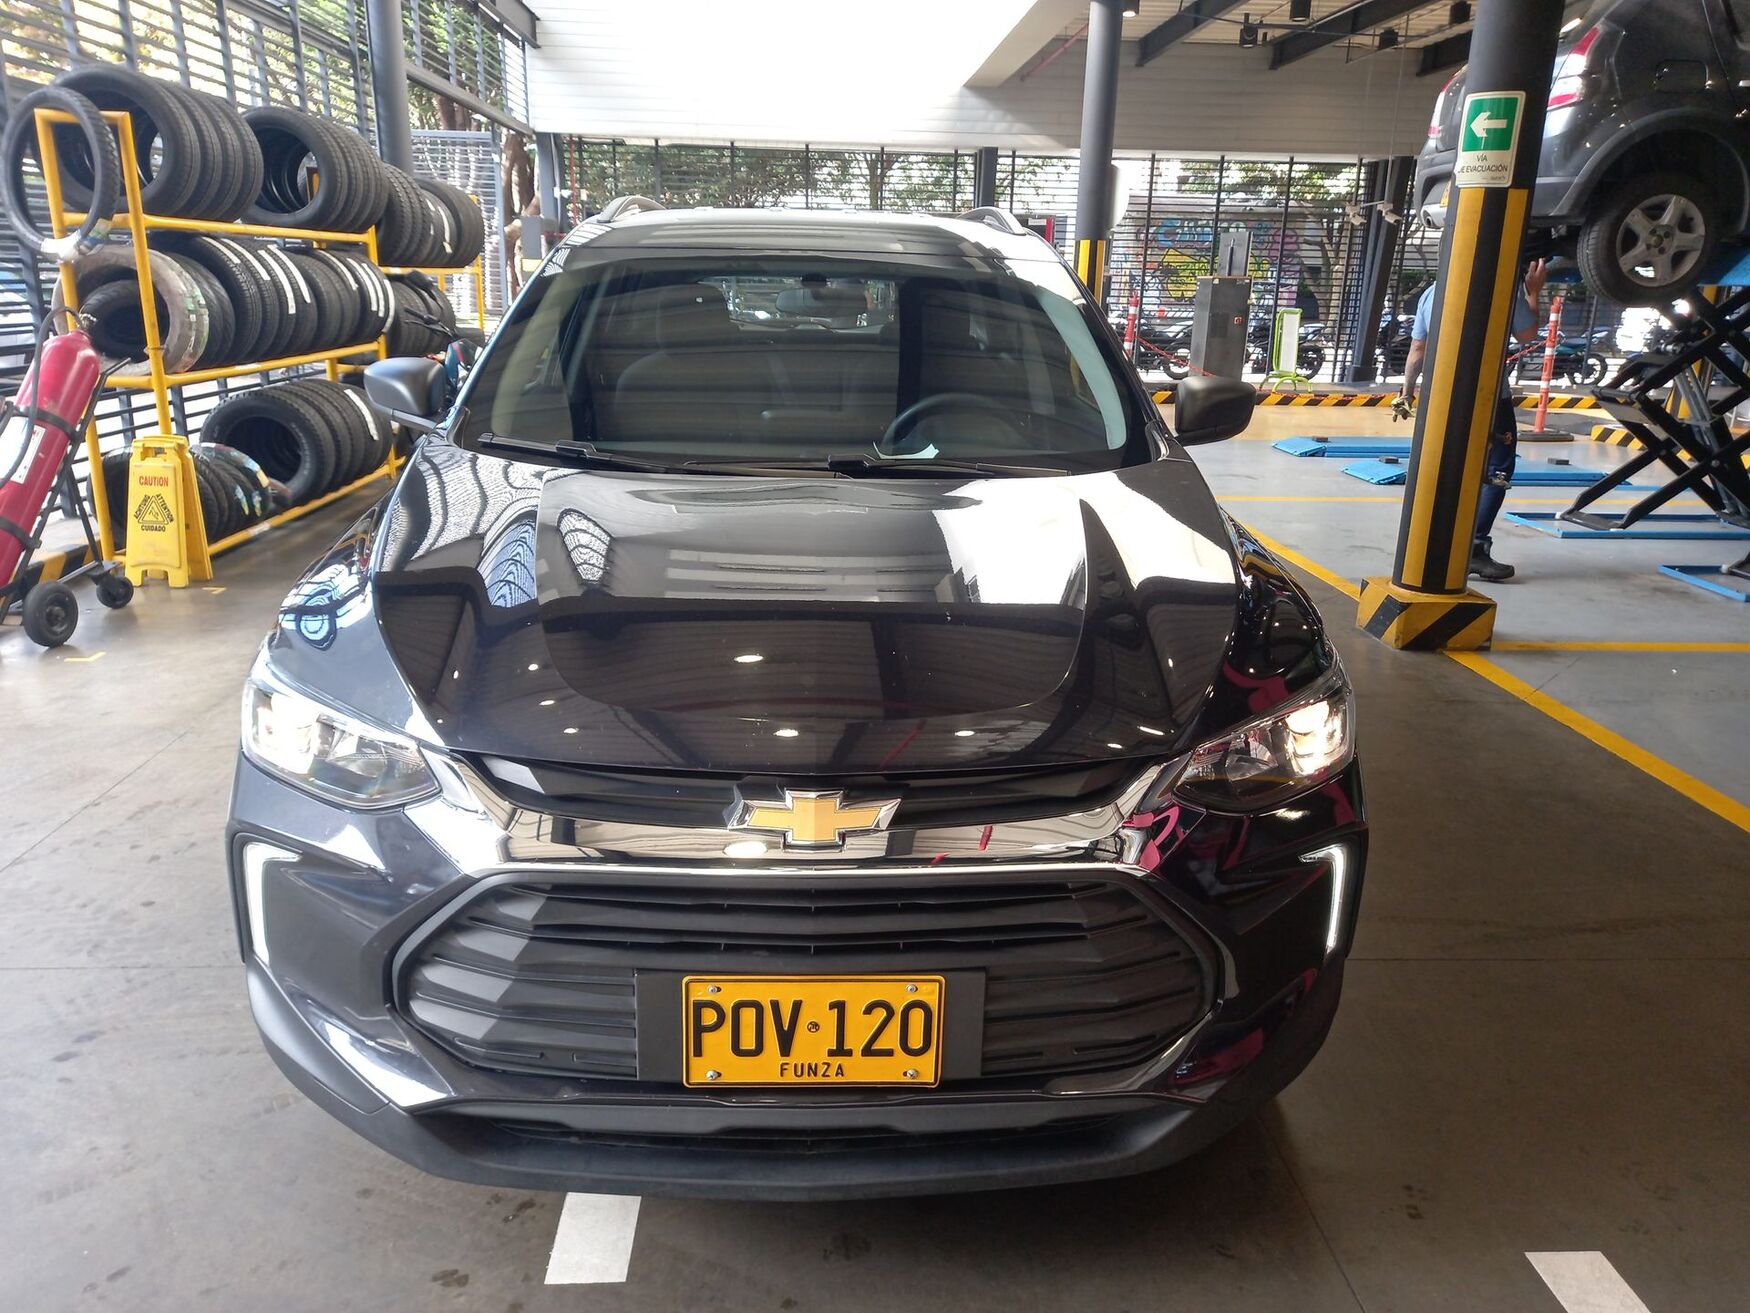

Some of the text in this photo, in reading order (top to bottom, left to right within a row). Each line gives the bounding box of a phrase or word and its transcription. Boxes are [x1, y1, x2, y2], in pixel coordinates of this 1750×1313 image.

[1466, 163, 1508, 173] EVACUACIÓN
[138, 475, 169, 487] CAUTION
[155, 493, 174, 523] ATTENTION
[140, 524, 167, 533] CUIDADO
[692, 999, 934, 1058] POV 120
[780, 1062, 846, 1078] FUNZA
